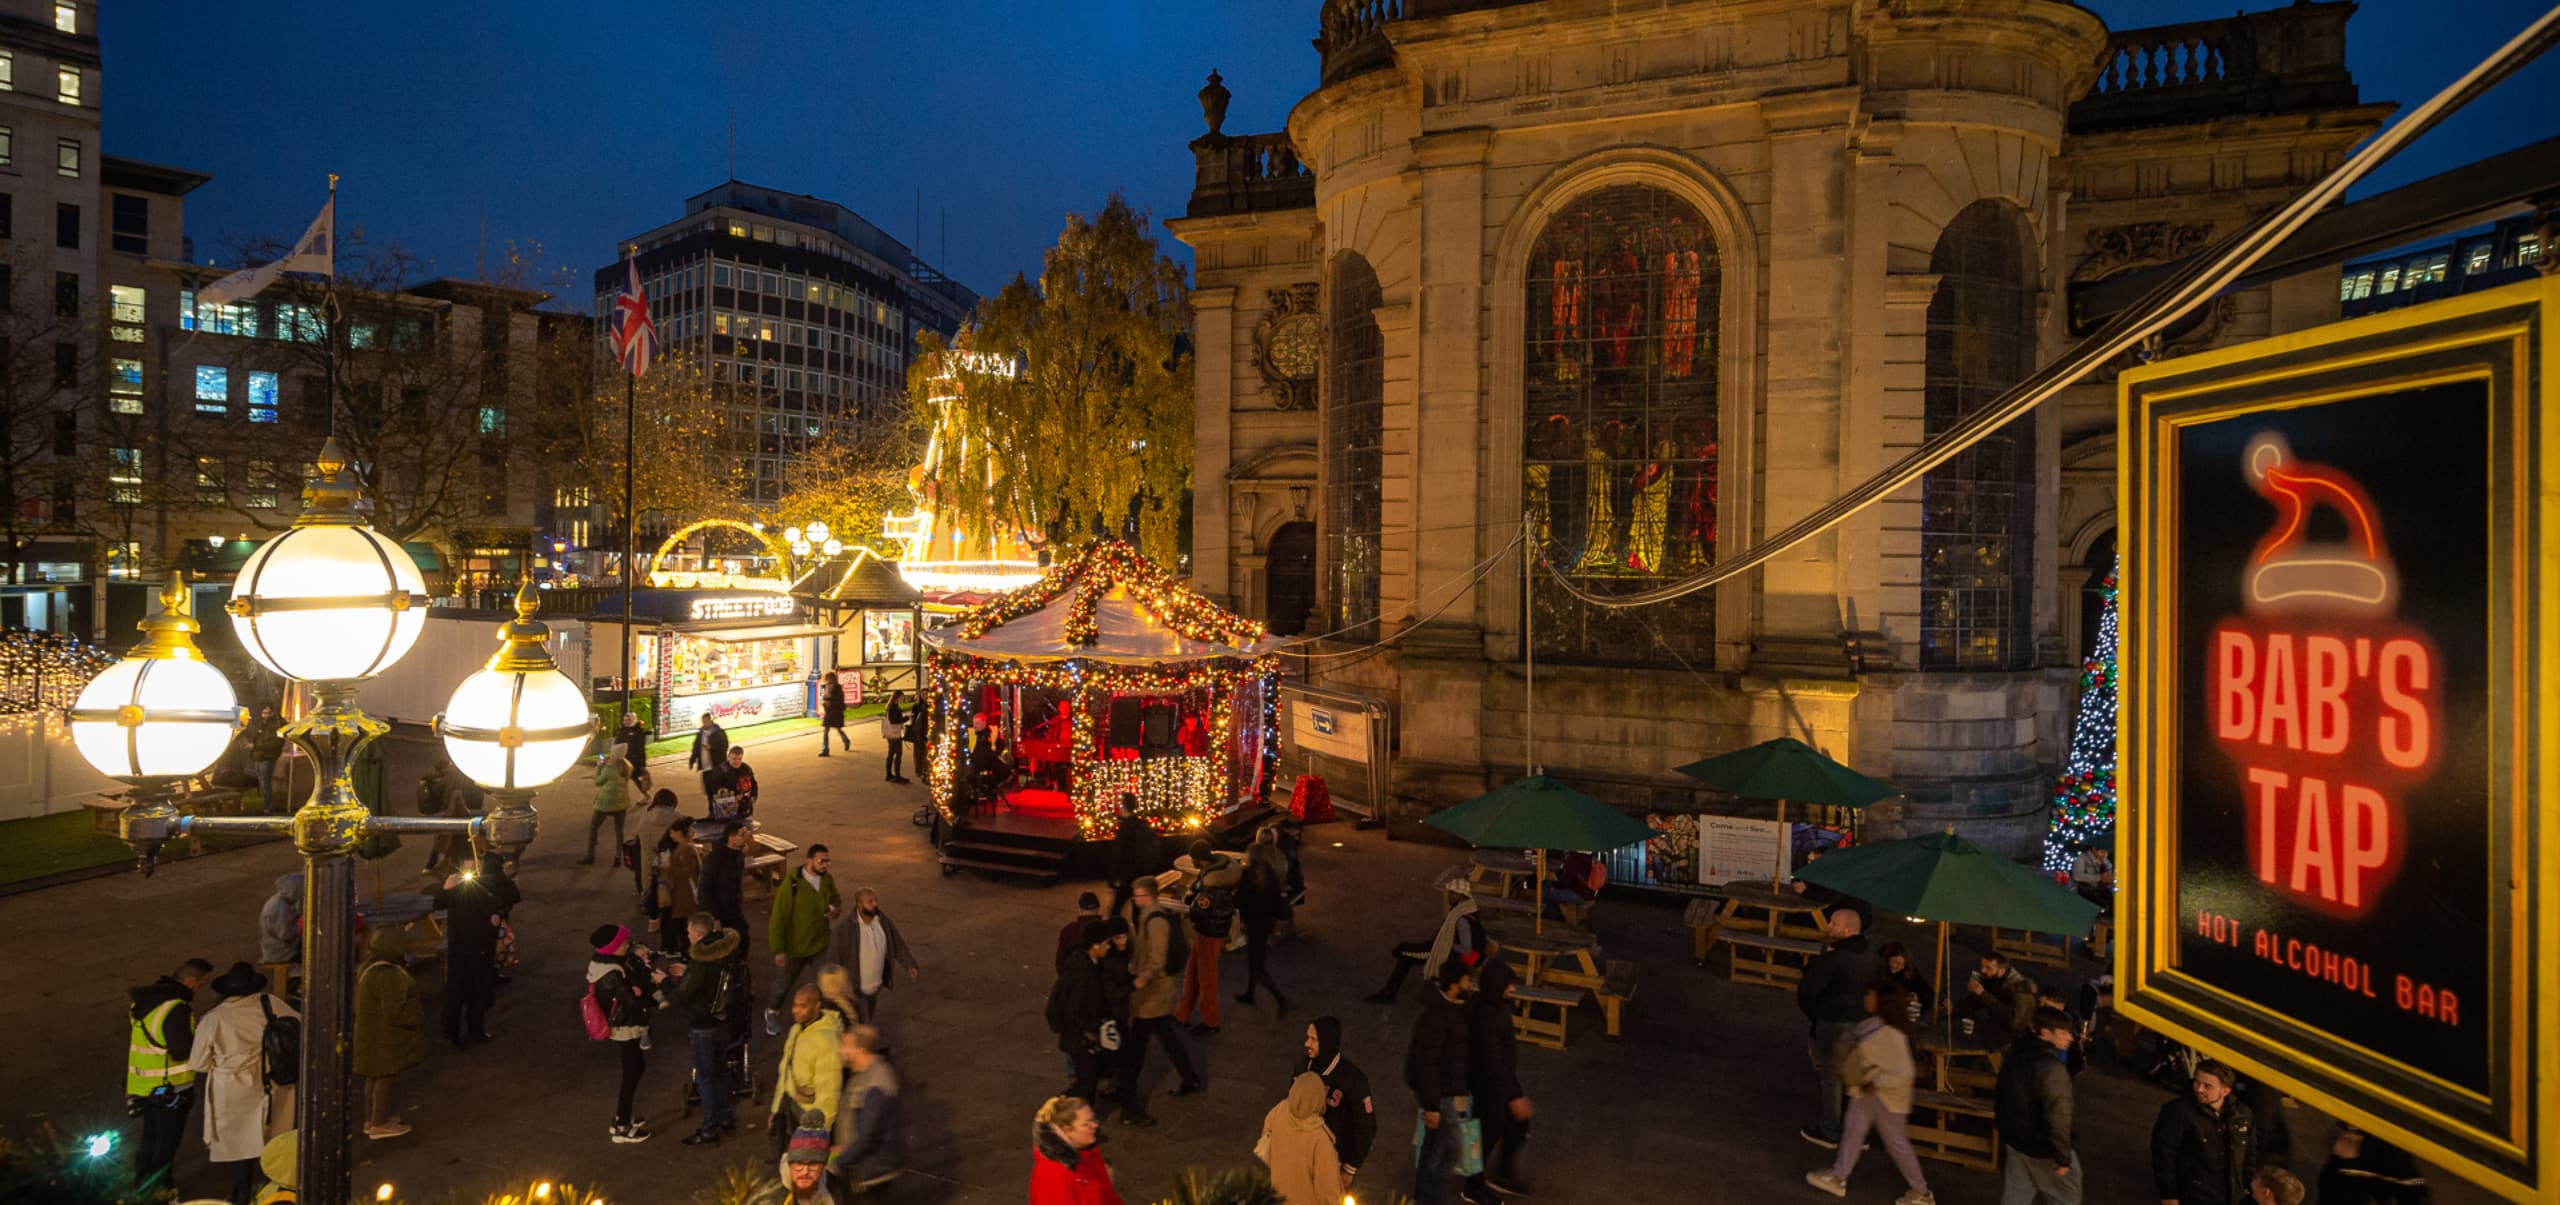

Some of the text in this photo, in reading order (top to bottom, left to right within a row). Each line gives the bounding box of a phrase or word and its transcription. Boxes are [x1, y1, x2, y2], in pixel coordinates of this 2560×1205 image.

[2219, 631, 2429, 768] BAB'S
[2249, 767, 2388, 907] TAP
[2198, 910, 2459, 1026] HOT ALCOHOL BAR
